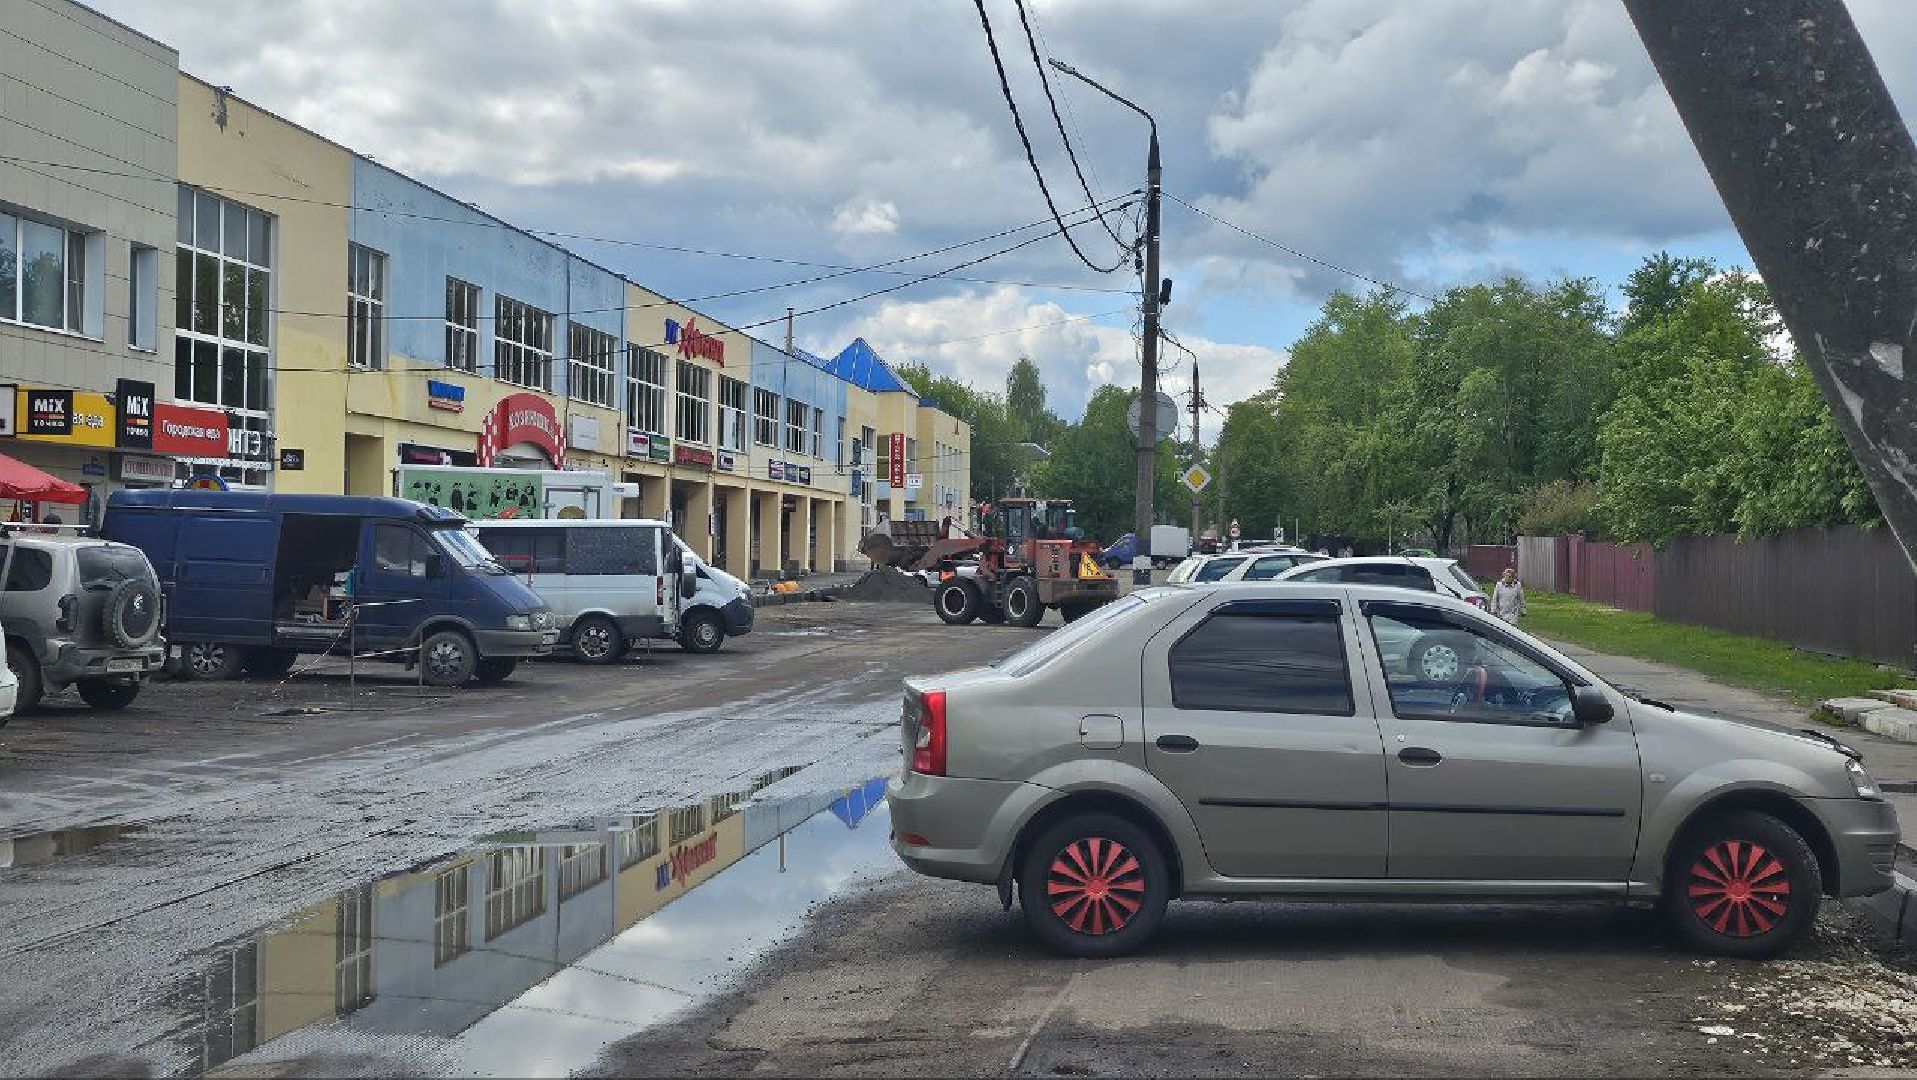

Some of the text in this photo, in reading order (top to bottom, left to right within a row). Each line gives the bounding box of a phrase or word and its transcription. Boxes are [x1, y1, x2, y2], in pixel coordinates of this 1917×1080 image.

[86, 414, 105, 429] еда
[163, 420, 221, 440] Городская еда
